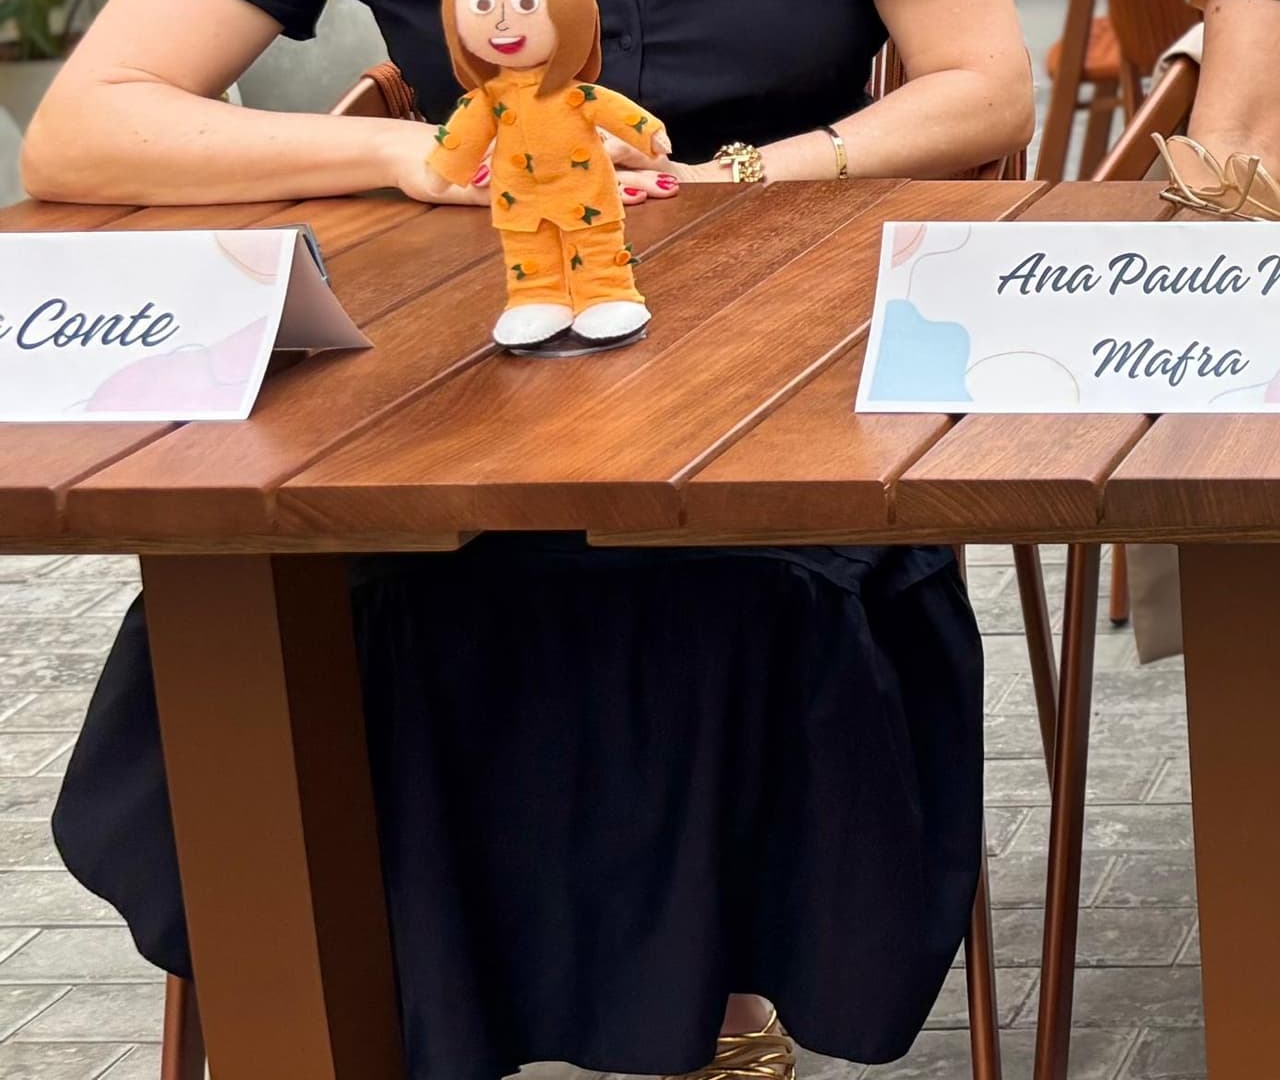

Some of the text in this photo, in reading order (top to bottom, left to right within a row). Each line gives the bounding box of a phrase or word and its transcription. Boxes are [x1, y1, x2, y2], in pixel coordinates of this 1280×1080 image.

[997, 252, 1103, 296] Ana
[1108, 252, 1251, 296] Paula
[16, 298, 180, 350] Conte
[1092, 338, 1251, 387] Mafra
